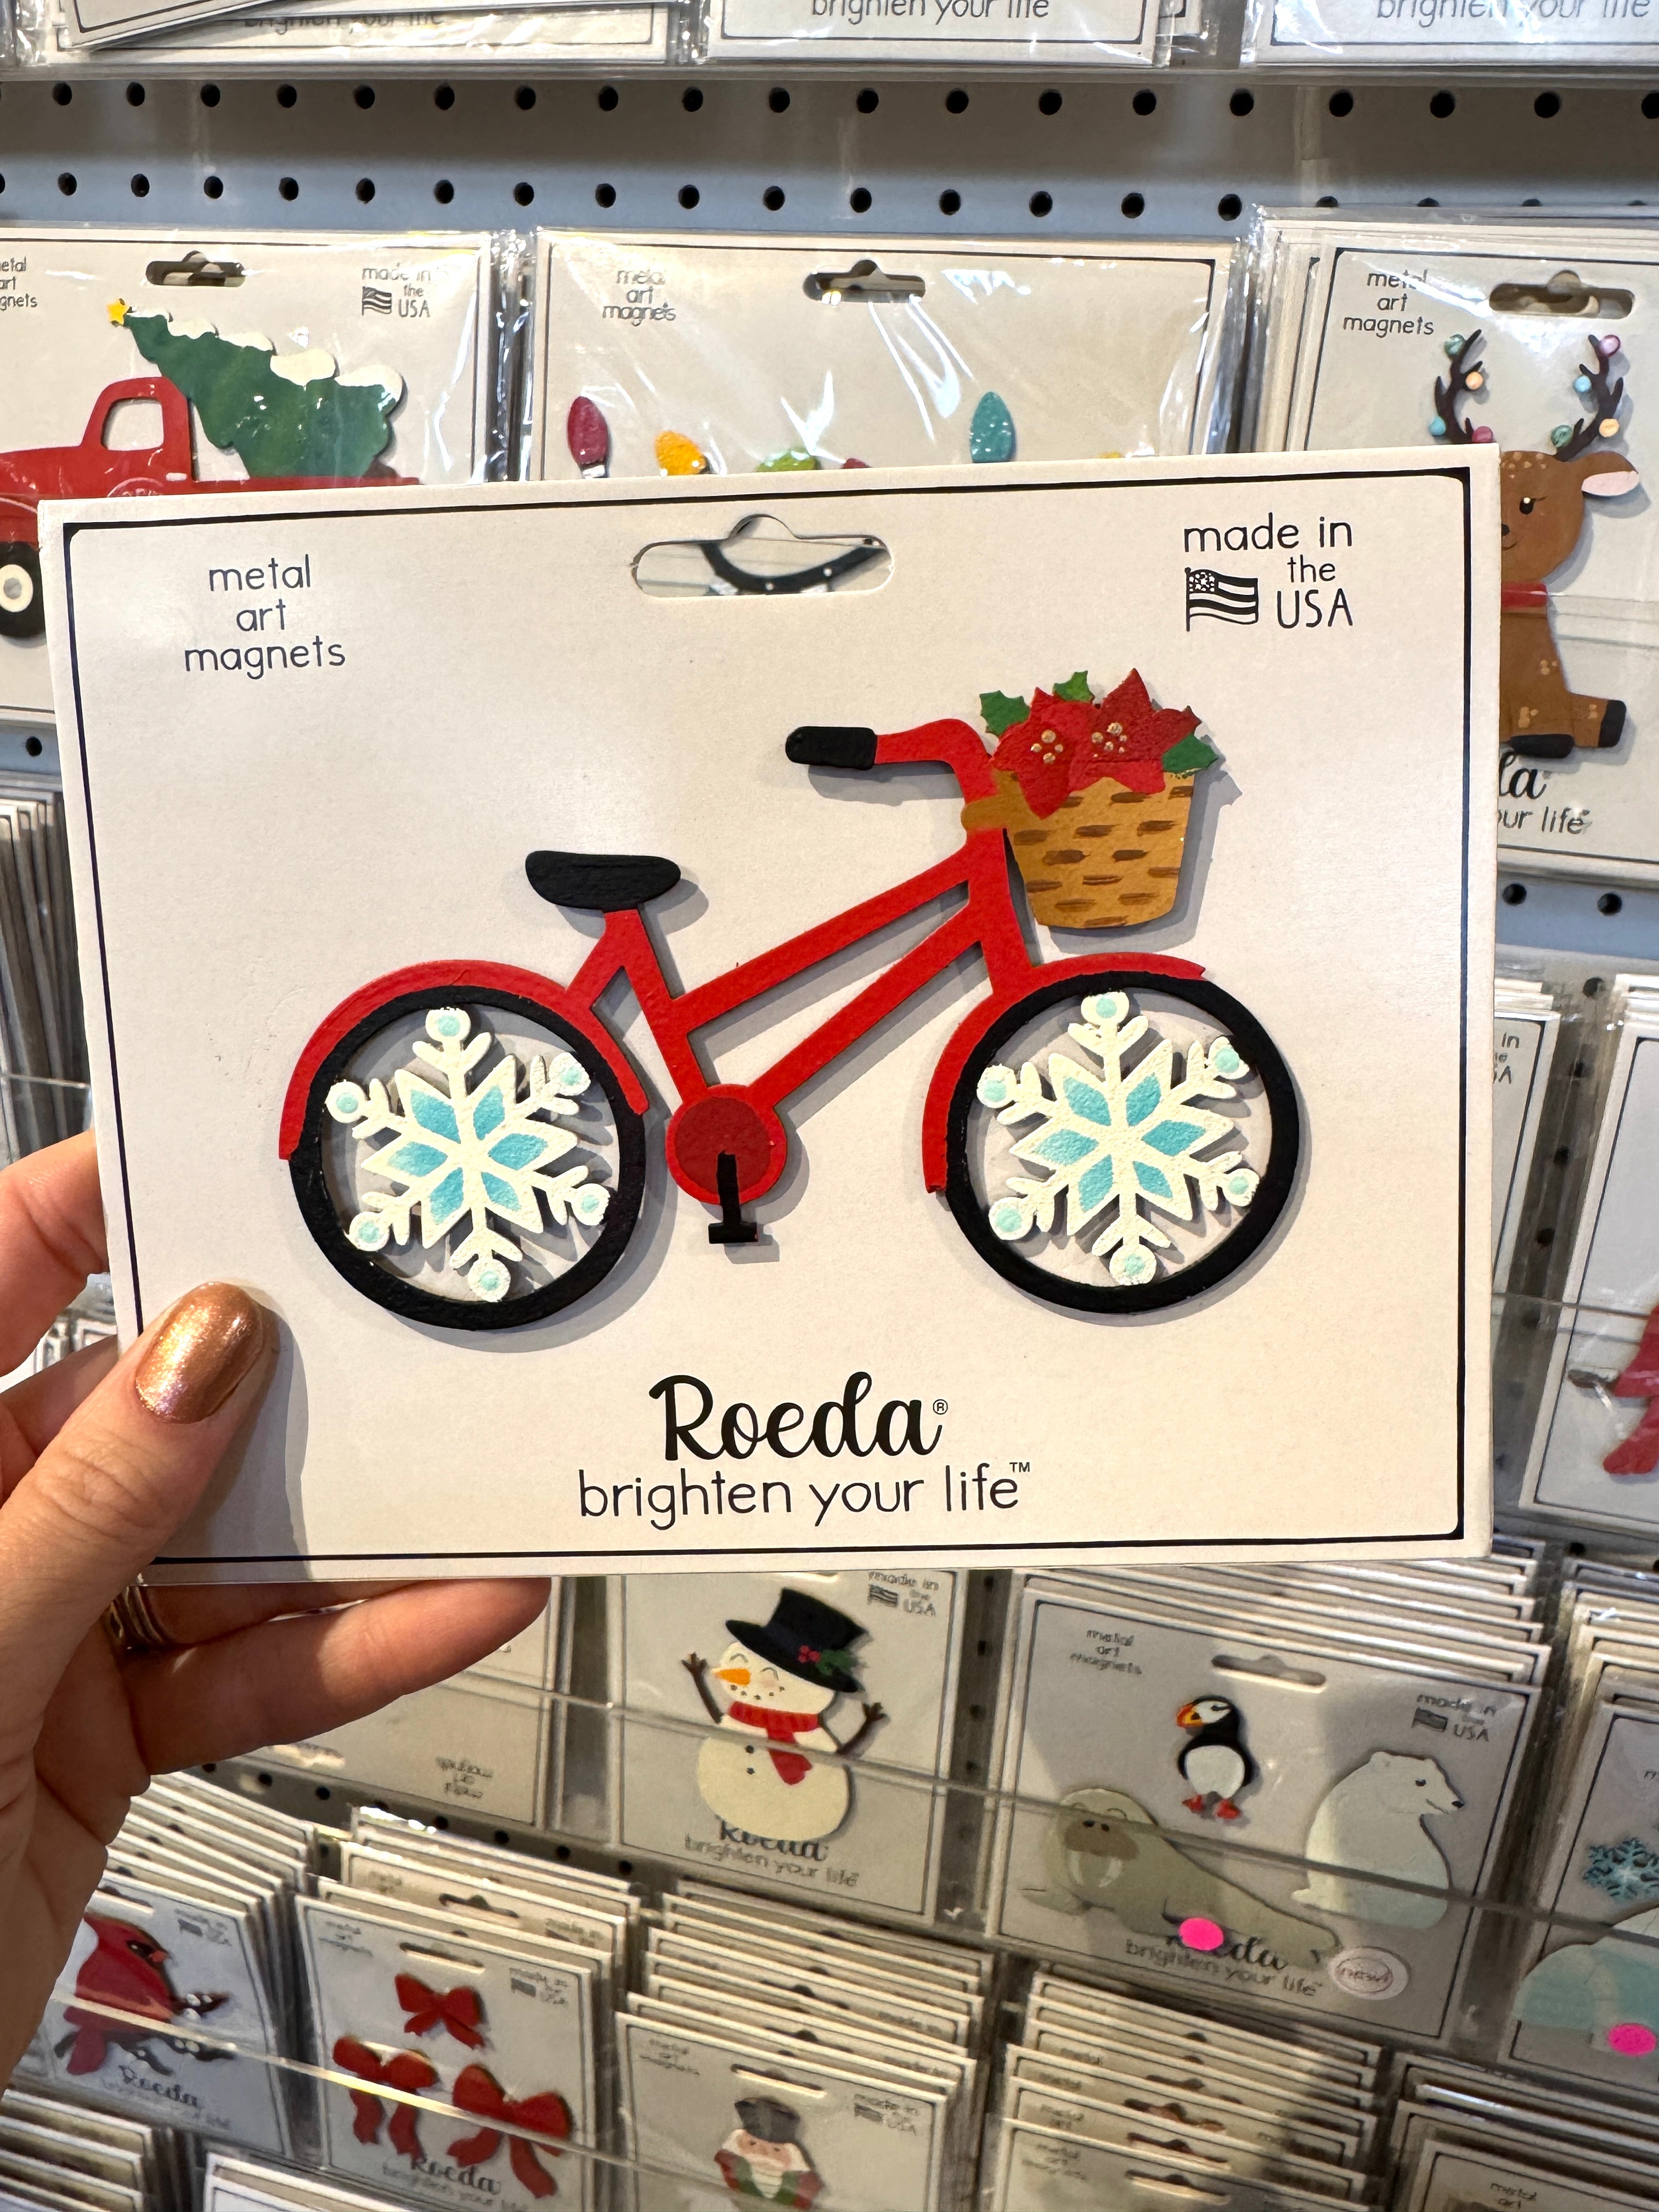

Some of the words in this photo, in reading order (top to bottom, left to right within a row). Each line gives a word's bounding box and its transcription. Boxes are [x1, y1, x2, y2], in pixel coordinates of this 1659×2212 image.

[935, 0, 990, 25] your
[0, 256, 26, 273] etal
[0, 293, 38, 312] gnets
[398, 298, 431, 318] USA
[625, 286, 653, 304] art
[1376, 293, 1408, 312] art
[602, 301, 677, 327] magnets
[1342, 316, 1435, 338] magnets
[1184, 511, 1299, 552] made
[1319, 516, 1352, 548] in
[208, 554, 311, 592] metal
[1286, 554, 1336, 583] the
[236, 598, 286, 632] art
[1277, 588, 1353, 629] USA
[184, 635, 346, 680] magnets
[578, 1468, 792, 1531] brighten
[809, 1479, 925, 1527] your
